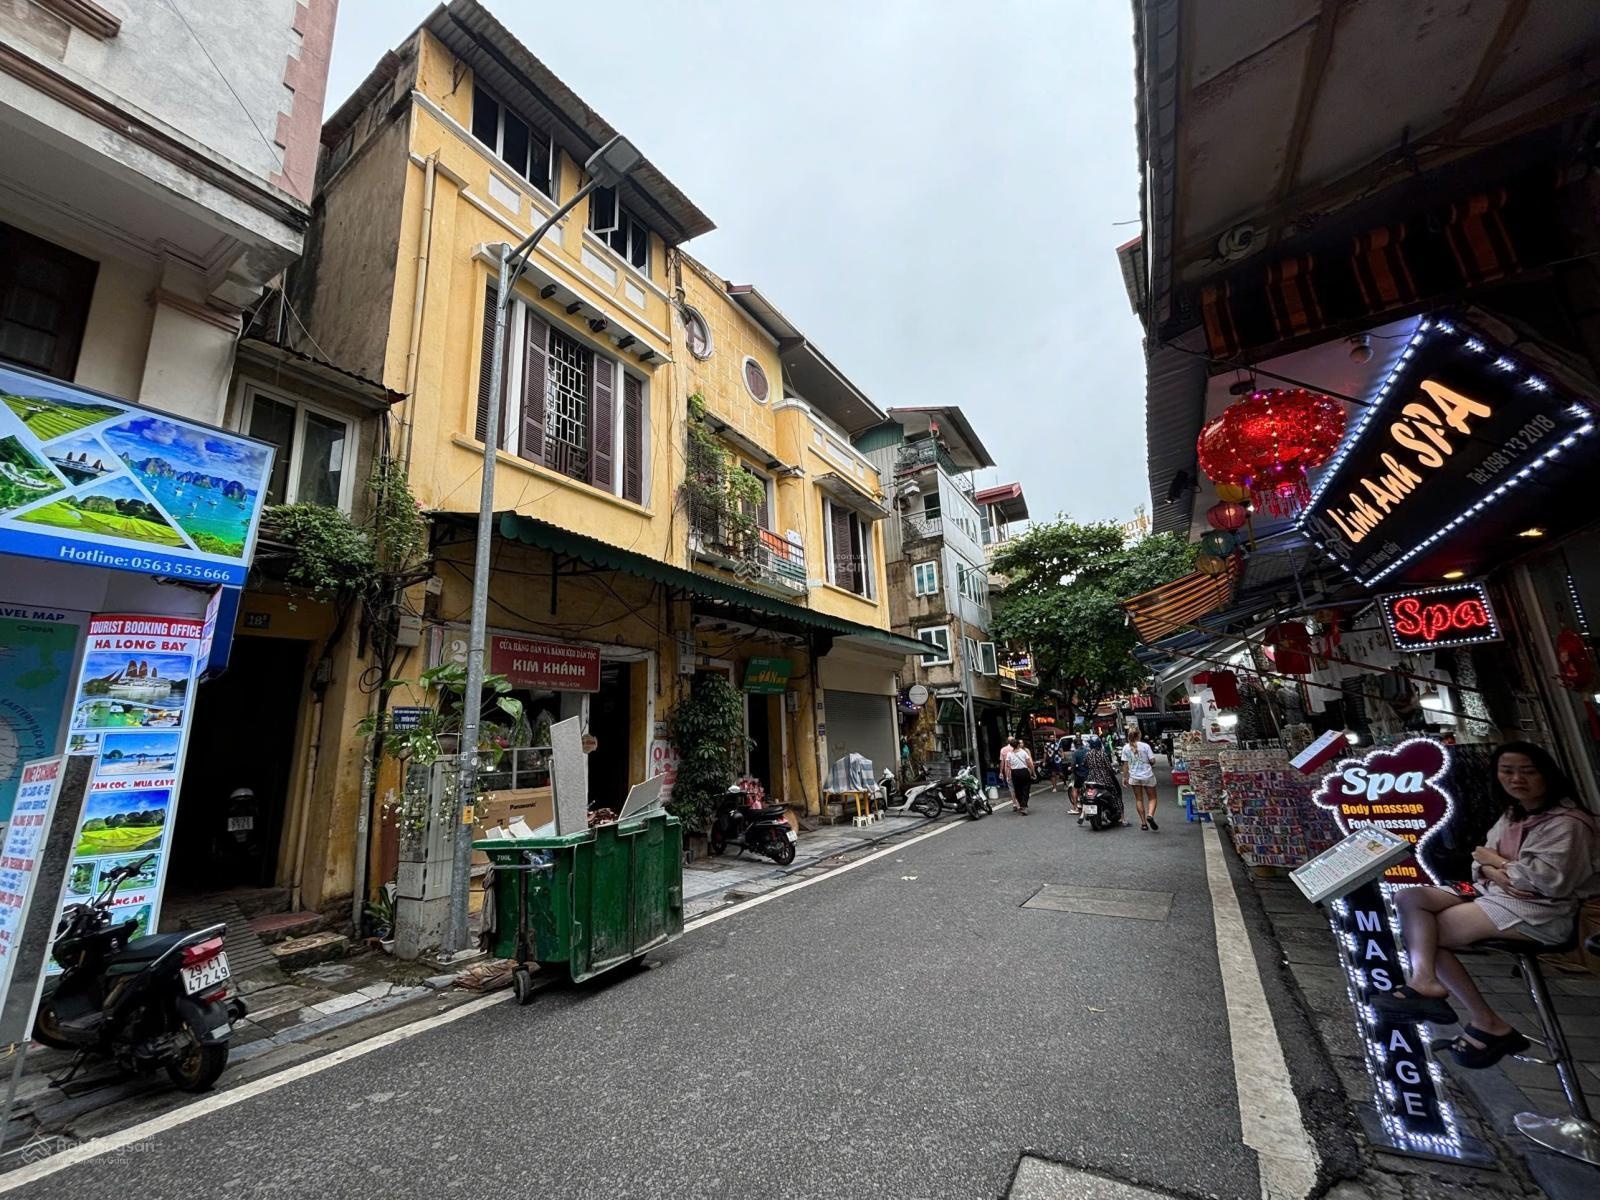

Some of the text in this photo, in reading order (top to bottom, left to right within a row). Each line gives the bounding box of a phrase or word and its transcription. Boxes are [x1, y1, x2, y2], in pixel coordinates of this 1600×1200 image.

[1390, 378, 1492, 469] SPA
[1465, 466, 1493, 485] Tel:
[1482, 451, 1511, 474] 098
[1519, 414, 1557, 444] 2018
[1361, 453, 1423, 514] Anh
[1327, 492, 1384, 544] Linh
[59, 545, 230, 581] Hotline: 0563 555 666
[32, 611, 65, 621] MAP
[1393, 598, 1488, 640] Spa
[89, 620, 202, 638] TOURIST BOOKING OFFICE
[94, 639, 188, 652] HA LONG BAY
[512, 659, 586, 676] KIM KHÁNH
[91, 782, 107, 790] TAM
[110, 781, 127, 789] COC
[133, 780, 153, 788] MUA
[1341, 767, 1424, 801] Spa
[1341, 803, 1424, 815] Body massage
[1374, 818, 1427, 830] massage
[1384, 865, 1417, 878] axing
[131, 895, 146, 904] AN
[189, 957, 221, 978] 29-C1
[189, 967, 228, 991] 472.49
[1353, 910, 1428, 1117] MASAGE
